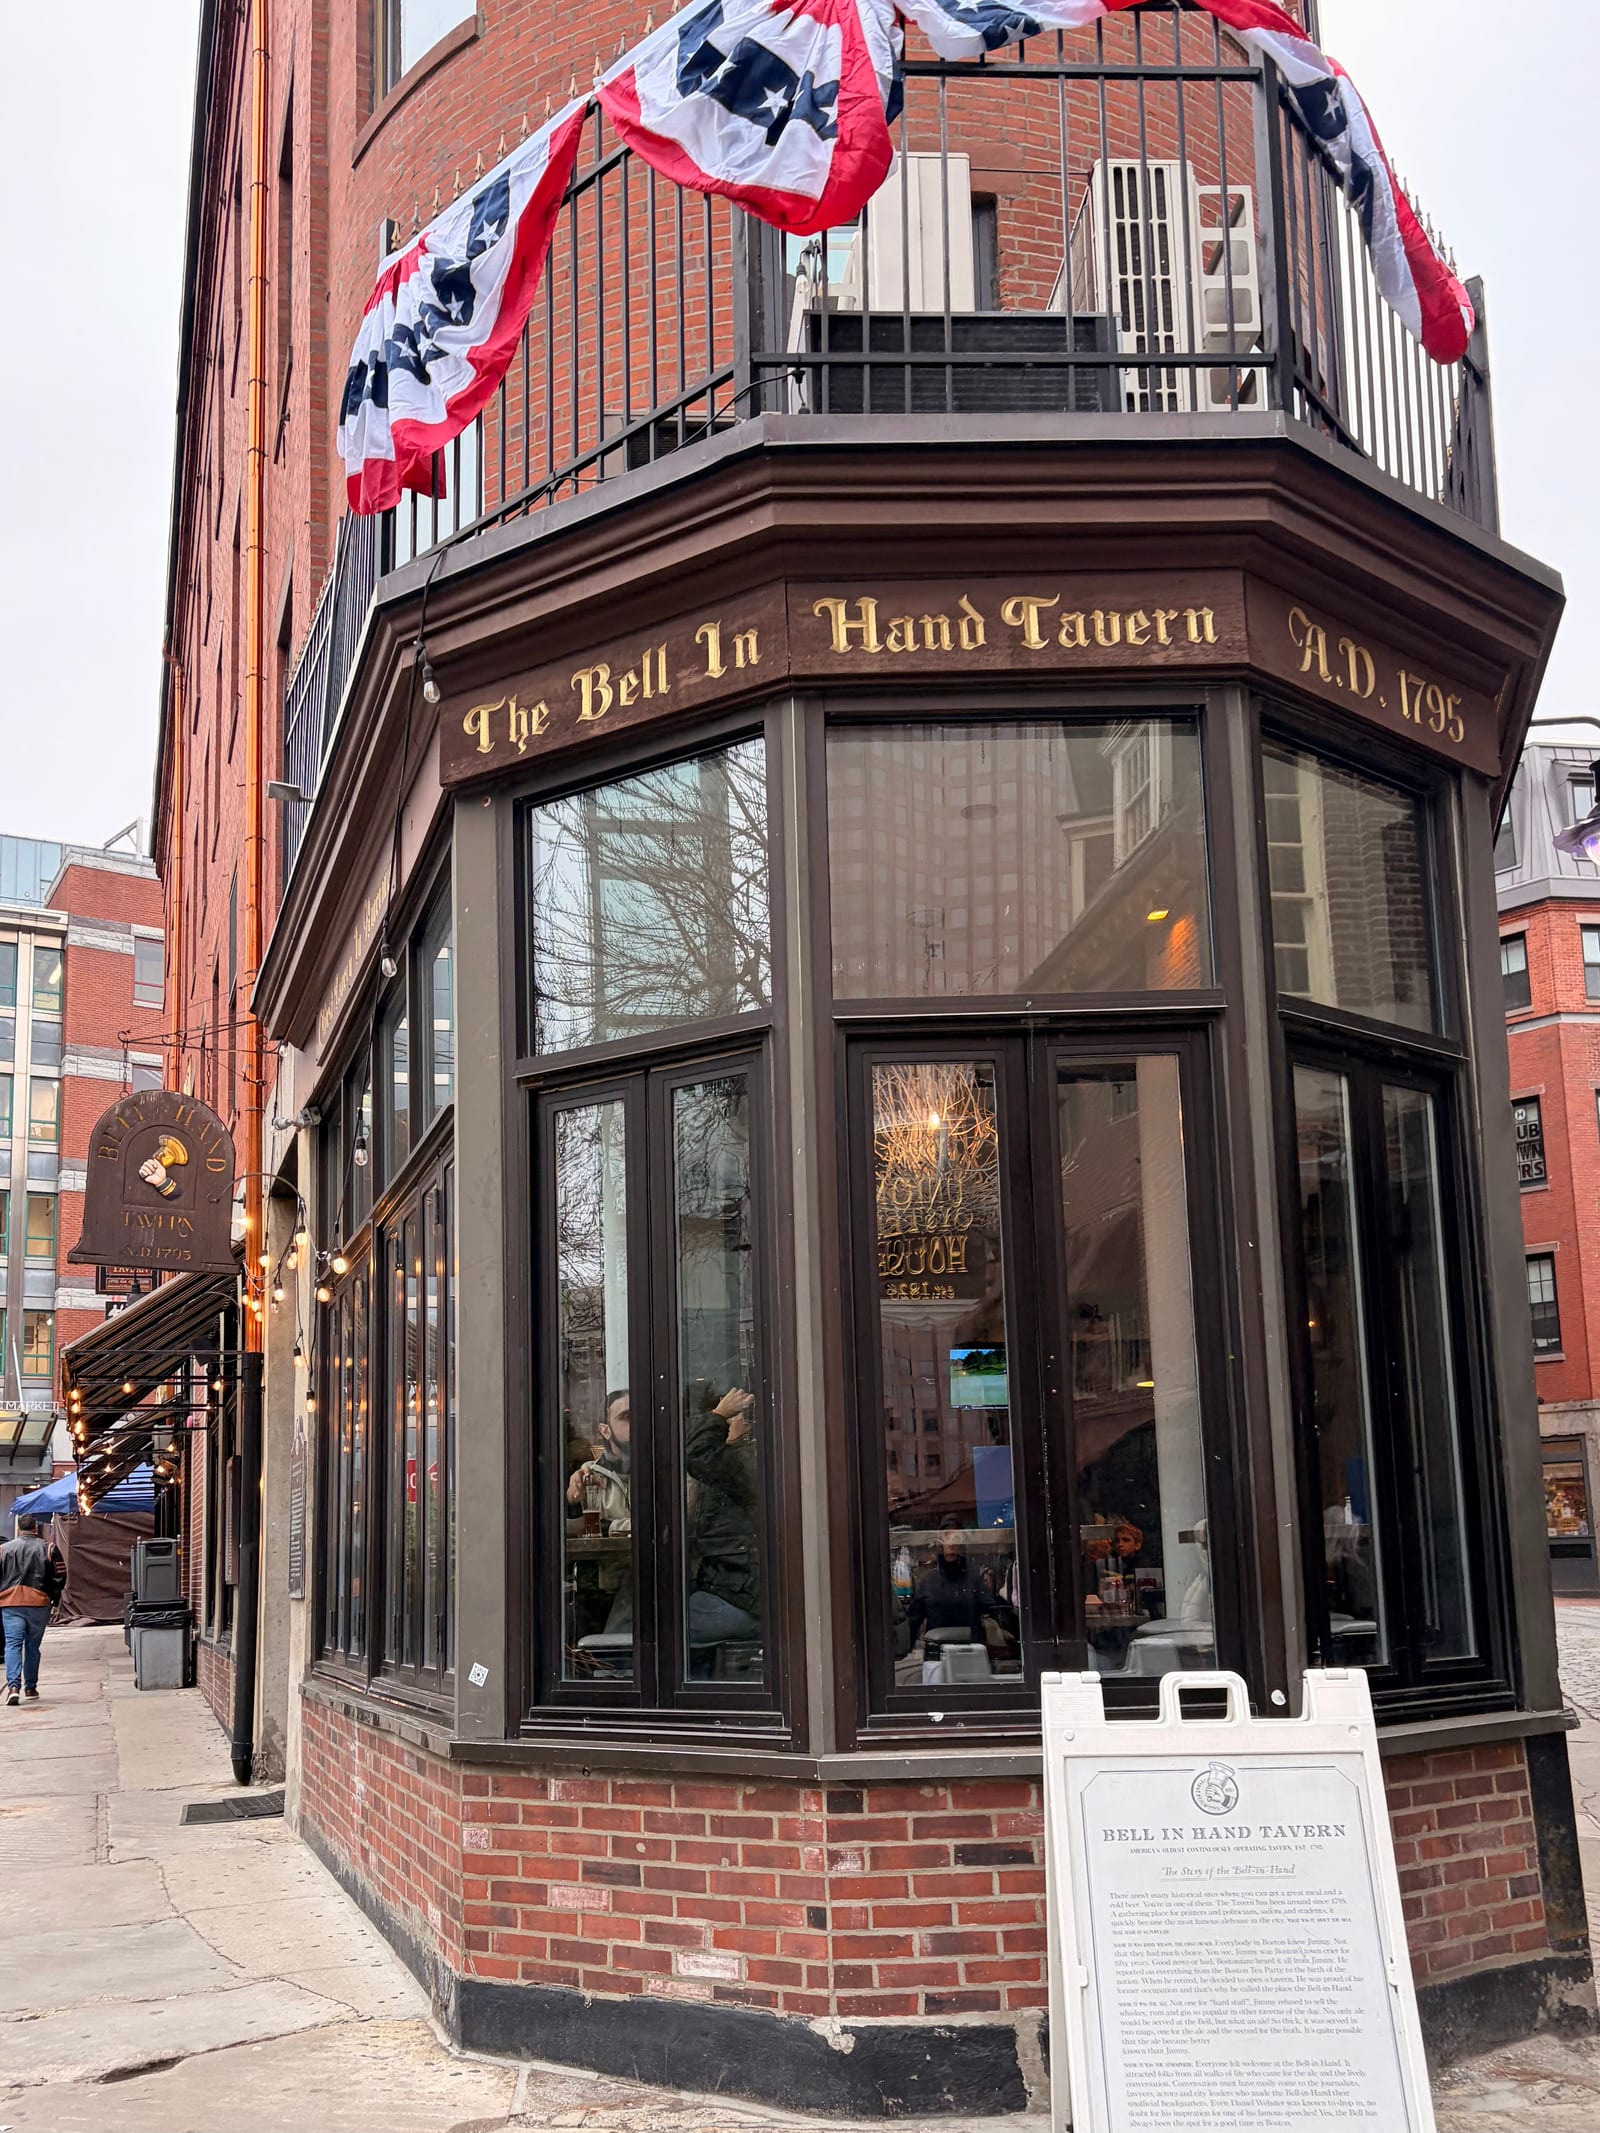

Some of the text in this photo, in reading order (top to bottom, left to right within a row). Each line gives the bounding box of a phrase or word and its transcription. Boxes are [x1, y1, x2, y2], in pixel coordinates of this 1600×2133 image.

[463, 593, 1465, 755] The Bell In Hand Tavern A.D. 1795
[1517, 1124, 1539, 1139] UB
[1517, 1144, 1541, 1160] WN
[1520, 1162, 1543, 1178] RS
[5, 1401, 59, 1411] MARKET
[1103, 1825, 1346, 1841] BELL IN HAND TAVERN
[1162, 1866, 1178, 1876] The
[1181, 1866, 1202, 1878] Story
[1217, 1865, 1230, 1875] the
